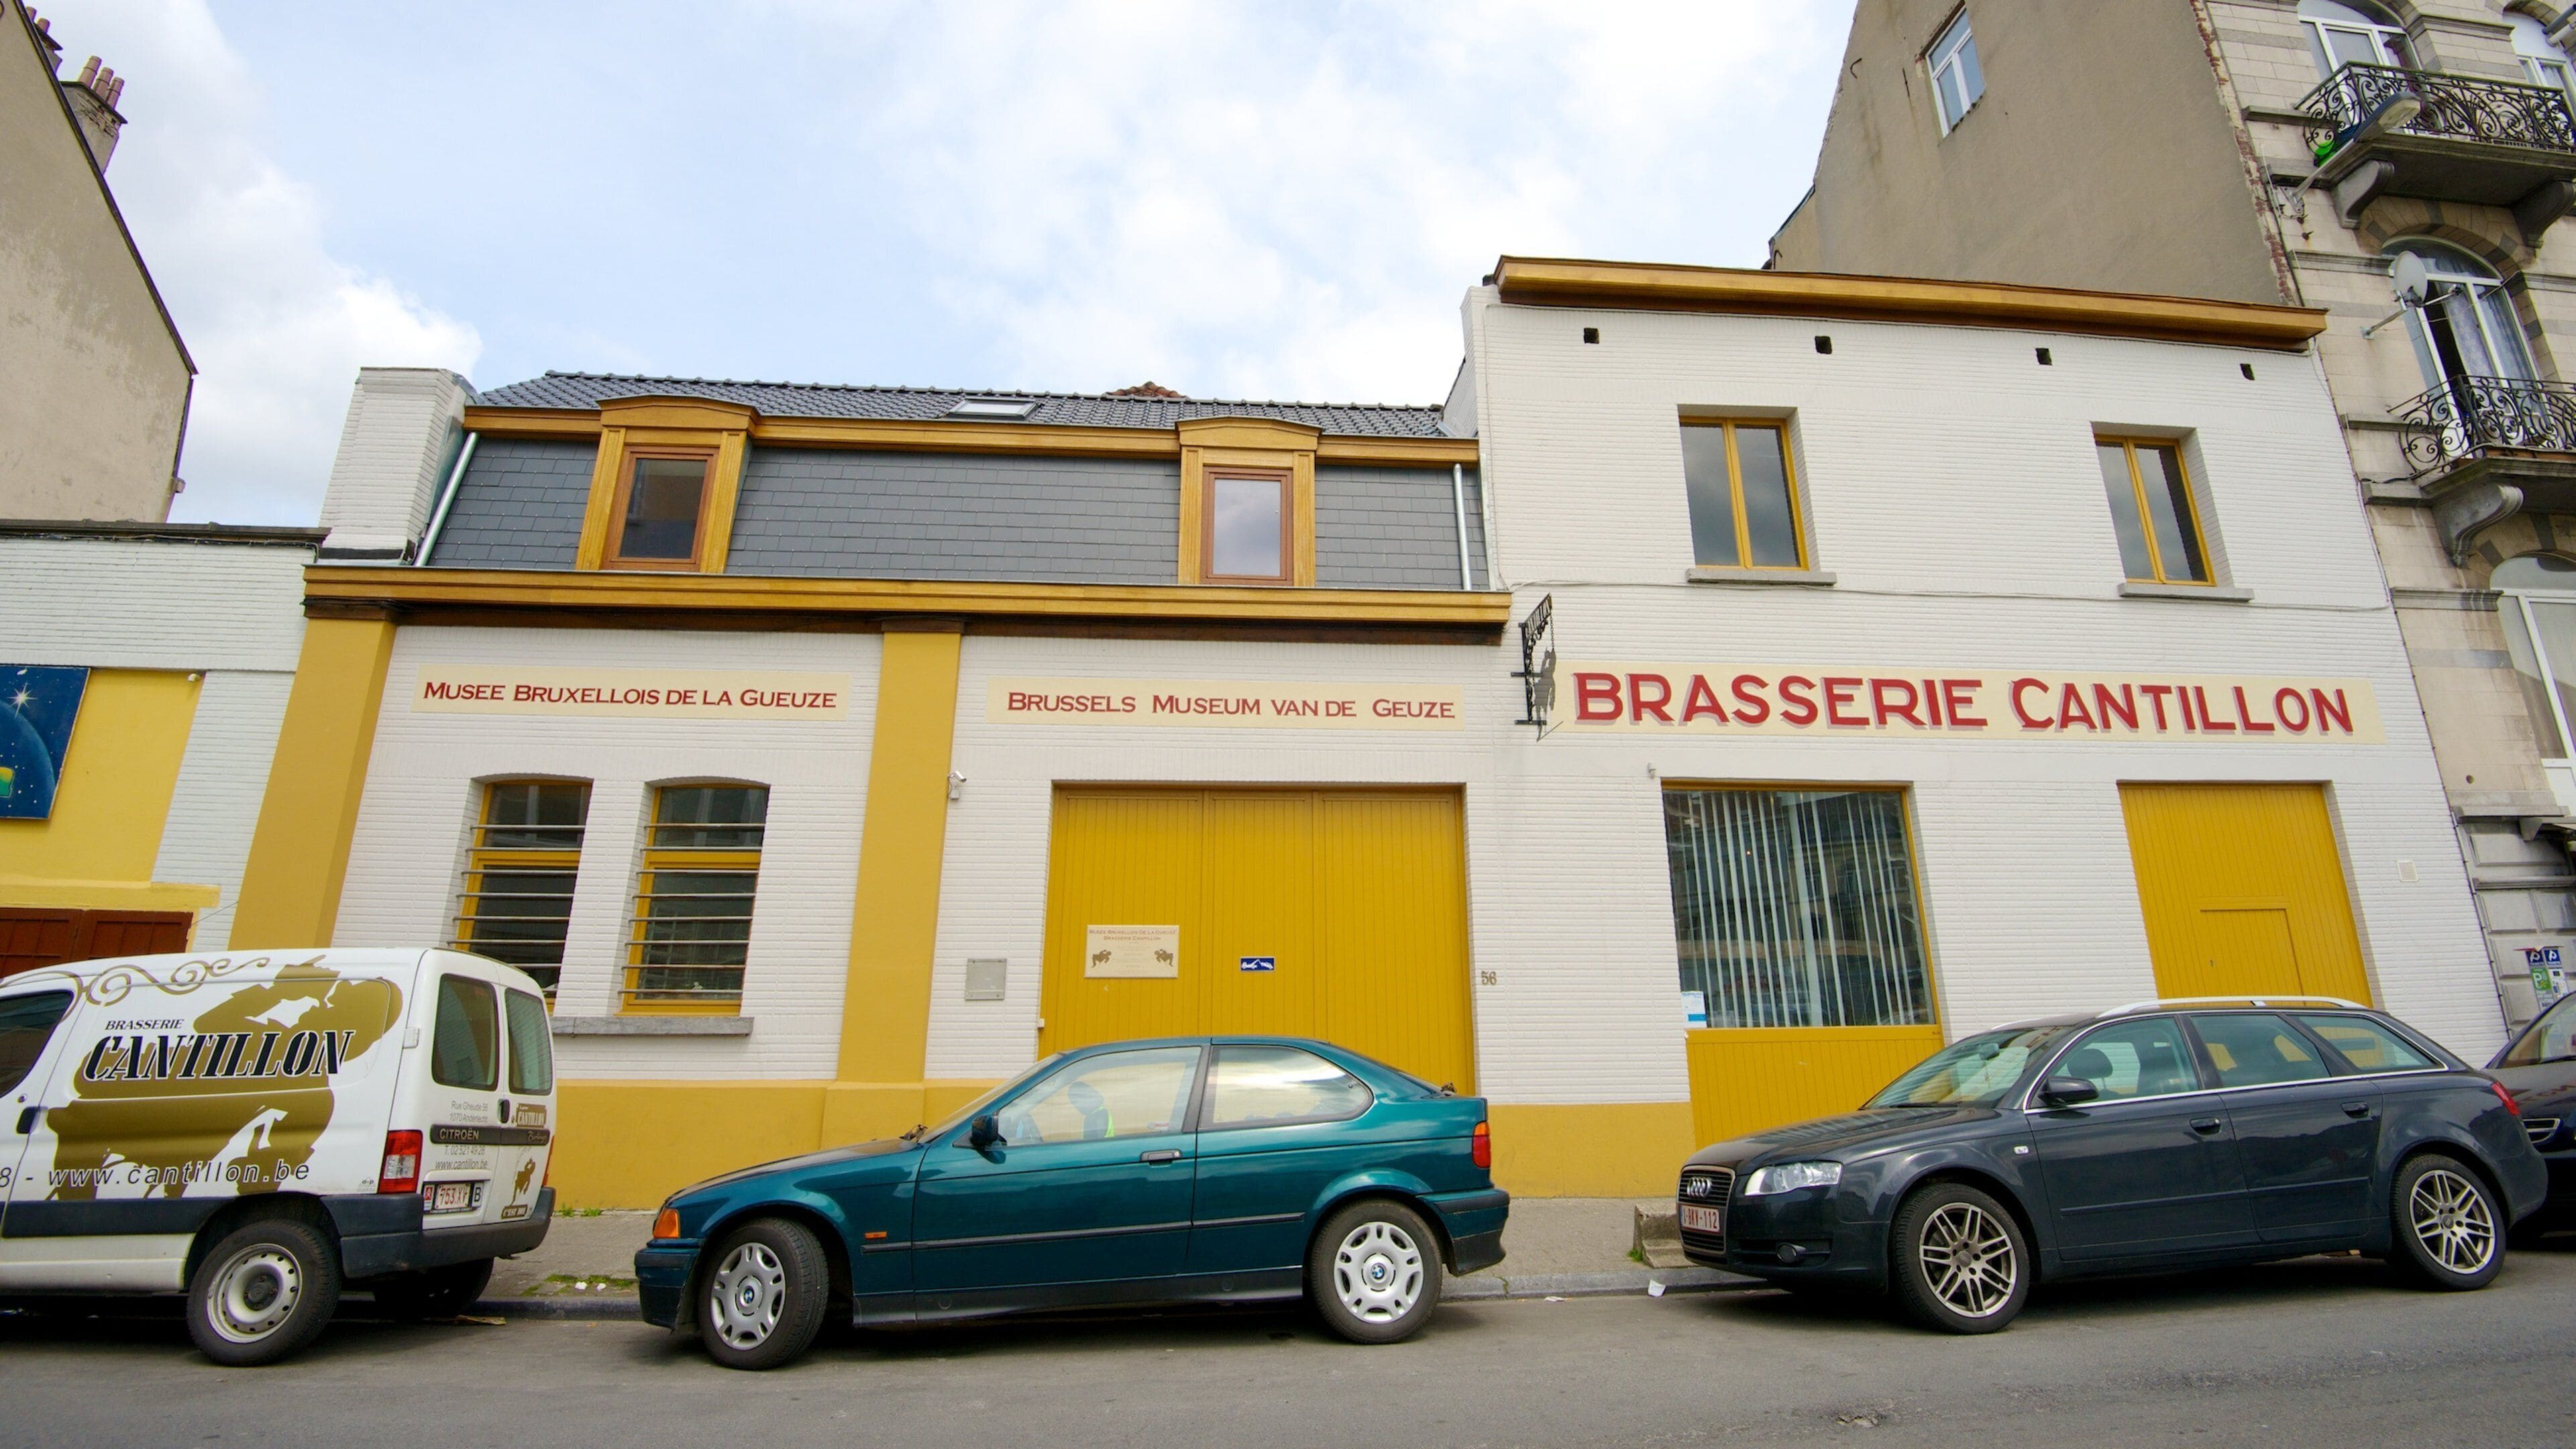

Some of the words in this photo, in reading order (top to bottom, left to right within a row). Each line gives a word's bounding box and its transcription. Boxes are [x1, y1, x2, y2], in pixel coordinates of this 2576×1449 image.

[424, 682, 505, 700] MUSEE
[514, 684, 660, 706] BRUXELLOIS
[665, 689, 698, 706] DE
[702, 690, 733, 706] LA
[740, 688, 837, 708] GUEUZE
[1008, 692, 1136, 713] BRUSSELS
[1152, 695, 1261, 716] MUSEUM
[1271, 699, 1319, 716] VAN
[1326, 700, 1356, 718] DE
[1373, 698, 1455, 719] GEUZE
[1573, 672, 1988, 727] BRASSERIE
[2011, 678, 2354, 733] CANTILLON
[1481, 971, 1497, 985] 56
[105, 1018, 184, 1030] BRASSERIE
[85, 1030, 354, 1081] CANTILLON
[439, 1128, 480, 1140] CITROËN
[48, 1159, 310, 1185] www.cantillon.be
[474, 1187, 482, 1202] B
